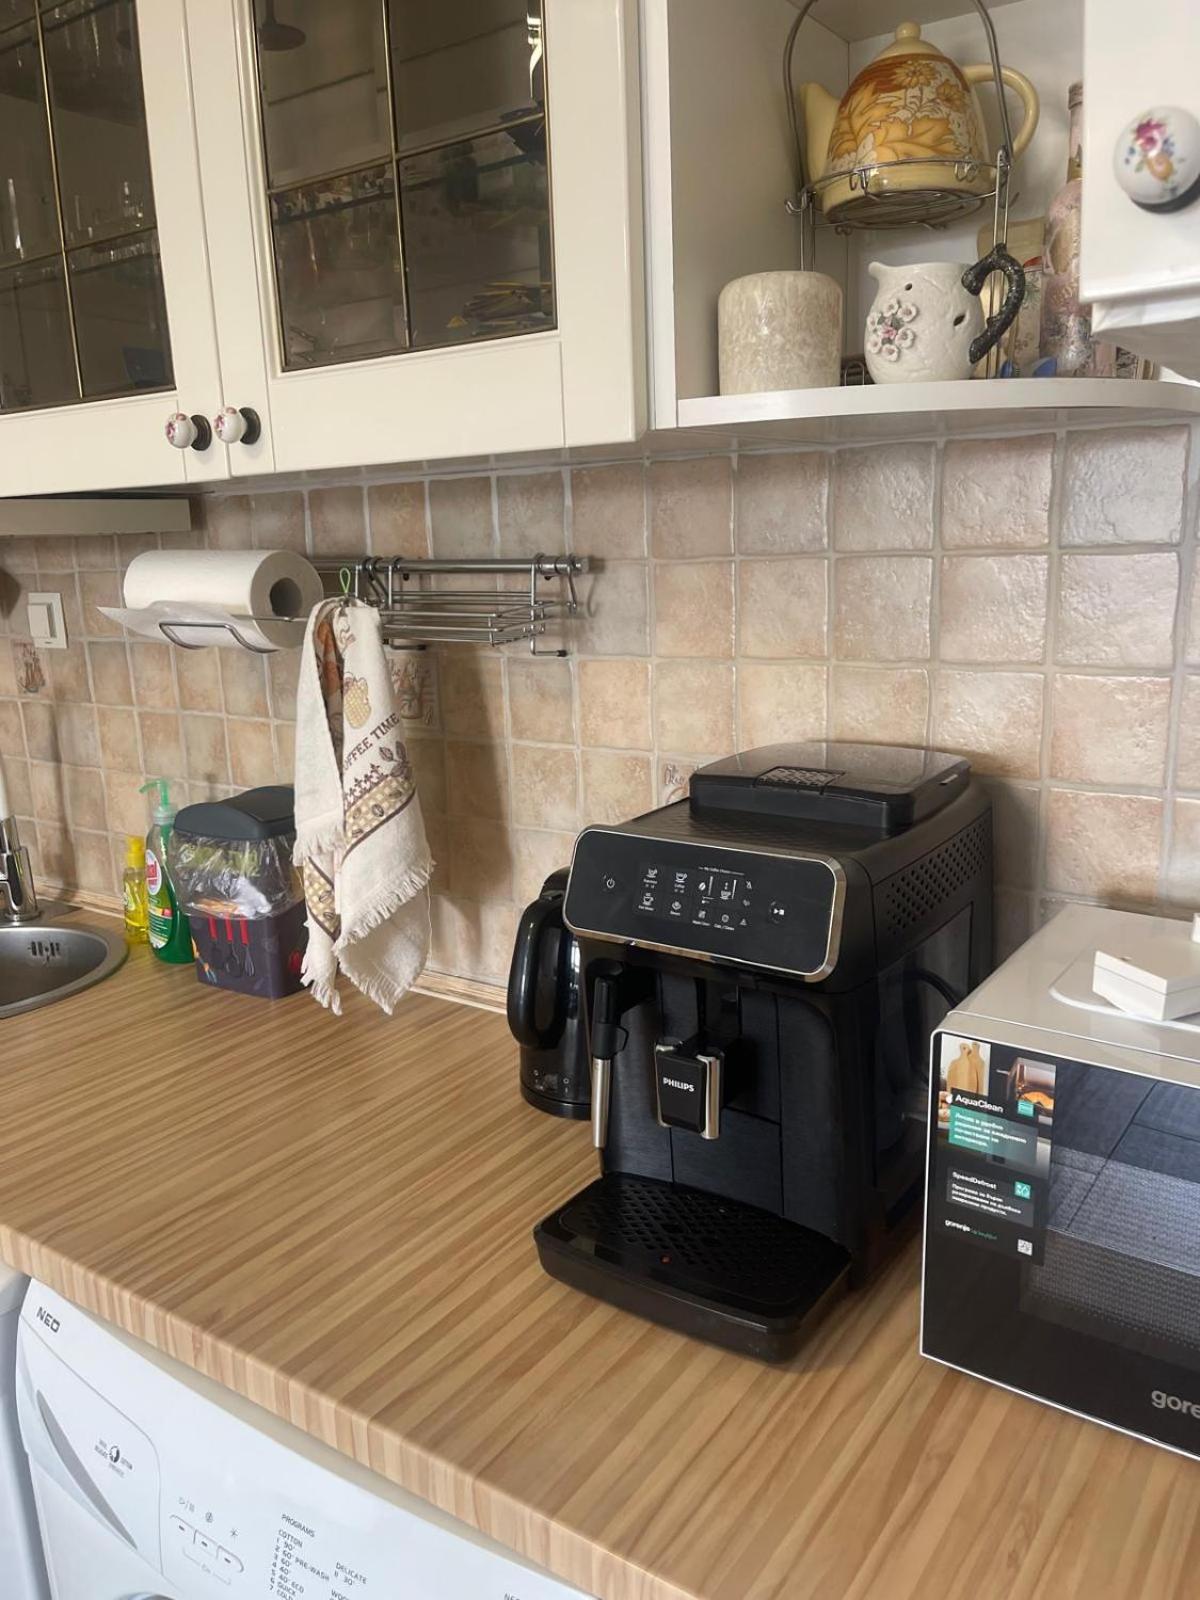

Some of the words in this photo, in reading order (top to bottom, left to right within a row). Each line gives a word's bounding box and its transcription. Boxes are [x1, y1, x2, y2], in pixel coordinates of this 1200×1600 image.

[370, 713, 400, 740] TIME
[663, 1076, 695, 1092] PHILIPS
[955, 1094, 1004, 1113] AquaClean
[36, 1306, 60, 1333] NEO
[281, 1513, 315, 1538] PROGRAMS
[278, 1529, 303, 1548] COTTON
